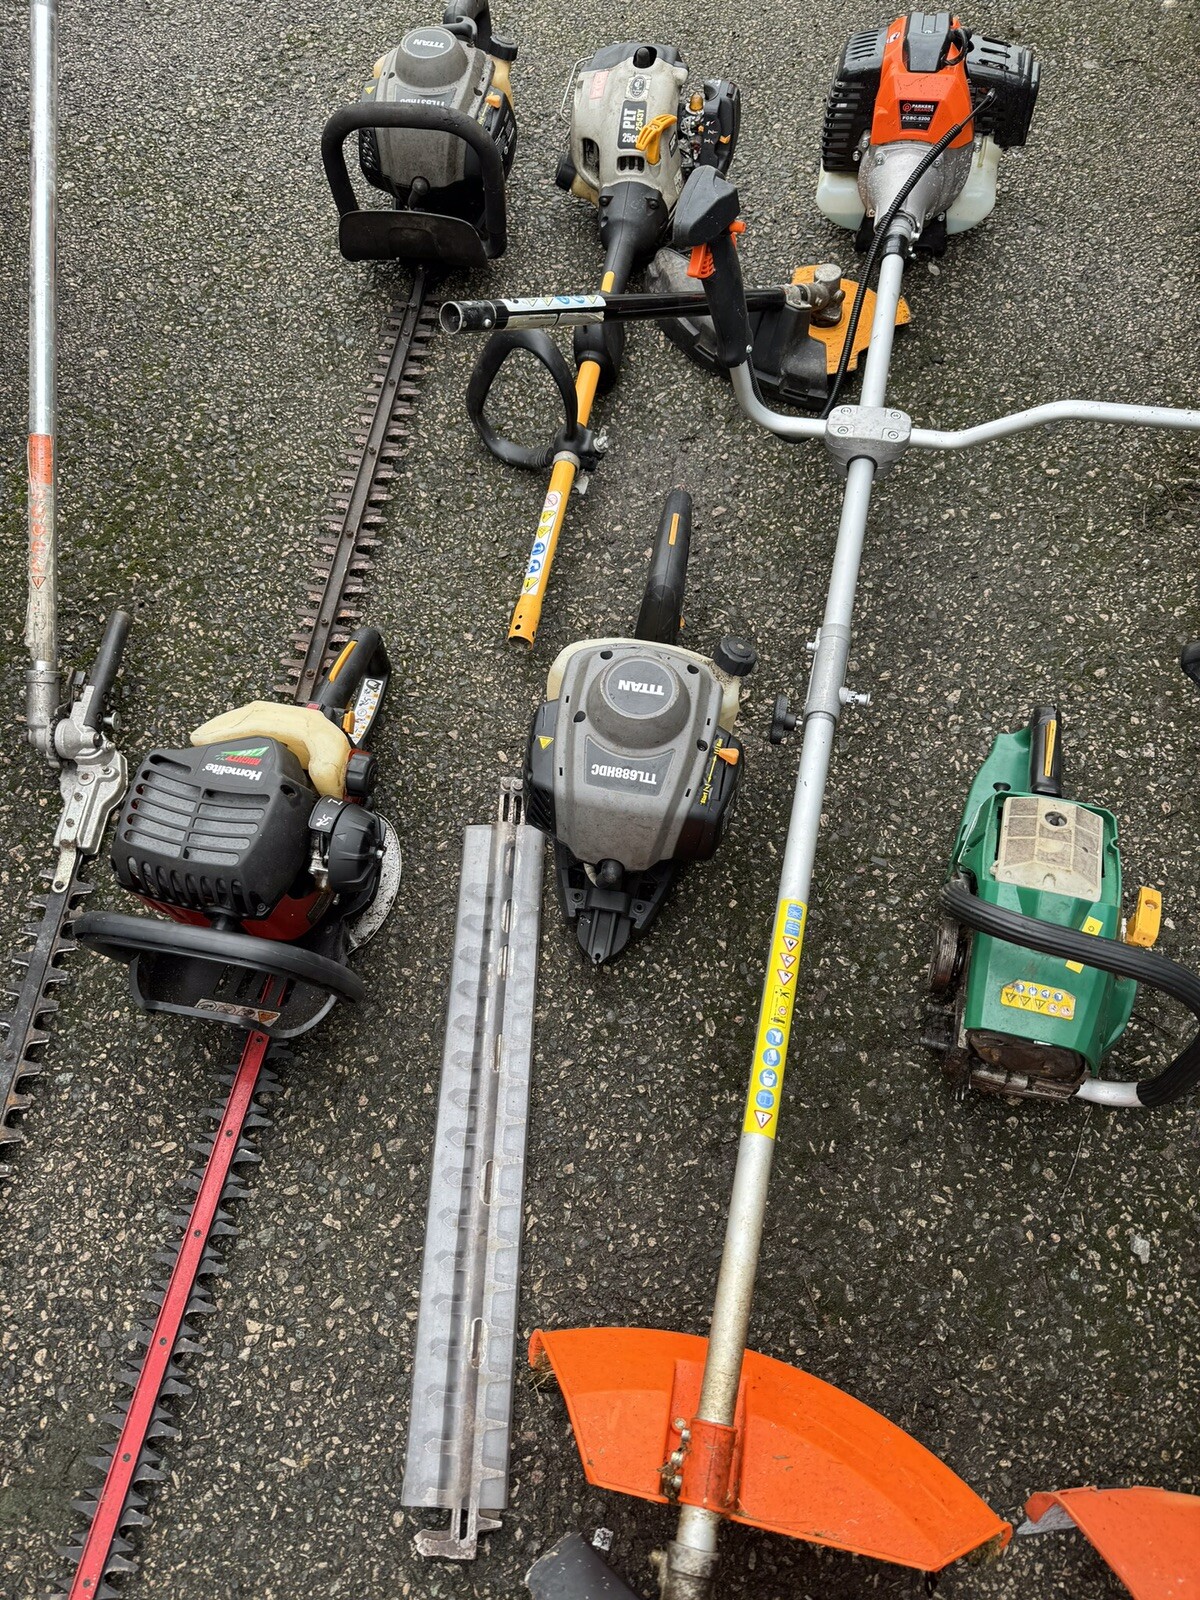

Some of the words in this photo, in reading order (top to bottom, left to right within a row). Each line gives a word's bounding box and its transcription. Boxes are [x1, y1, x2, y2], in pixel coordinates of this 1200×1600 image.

[412, 38, 445, 49] TITAN
[622, 108, 638, 129] PLT
[617, 679, 665, 696] TITAN
[204, 762, 263, 781] Homelite
[590, 763, 657, 785] TTL688HDC
